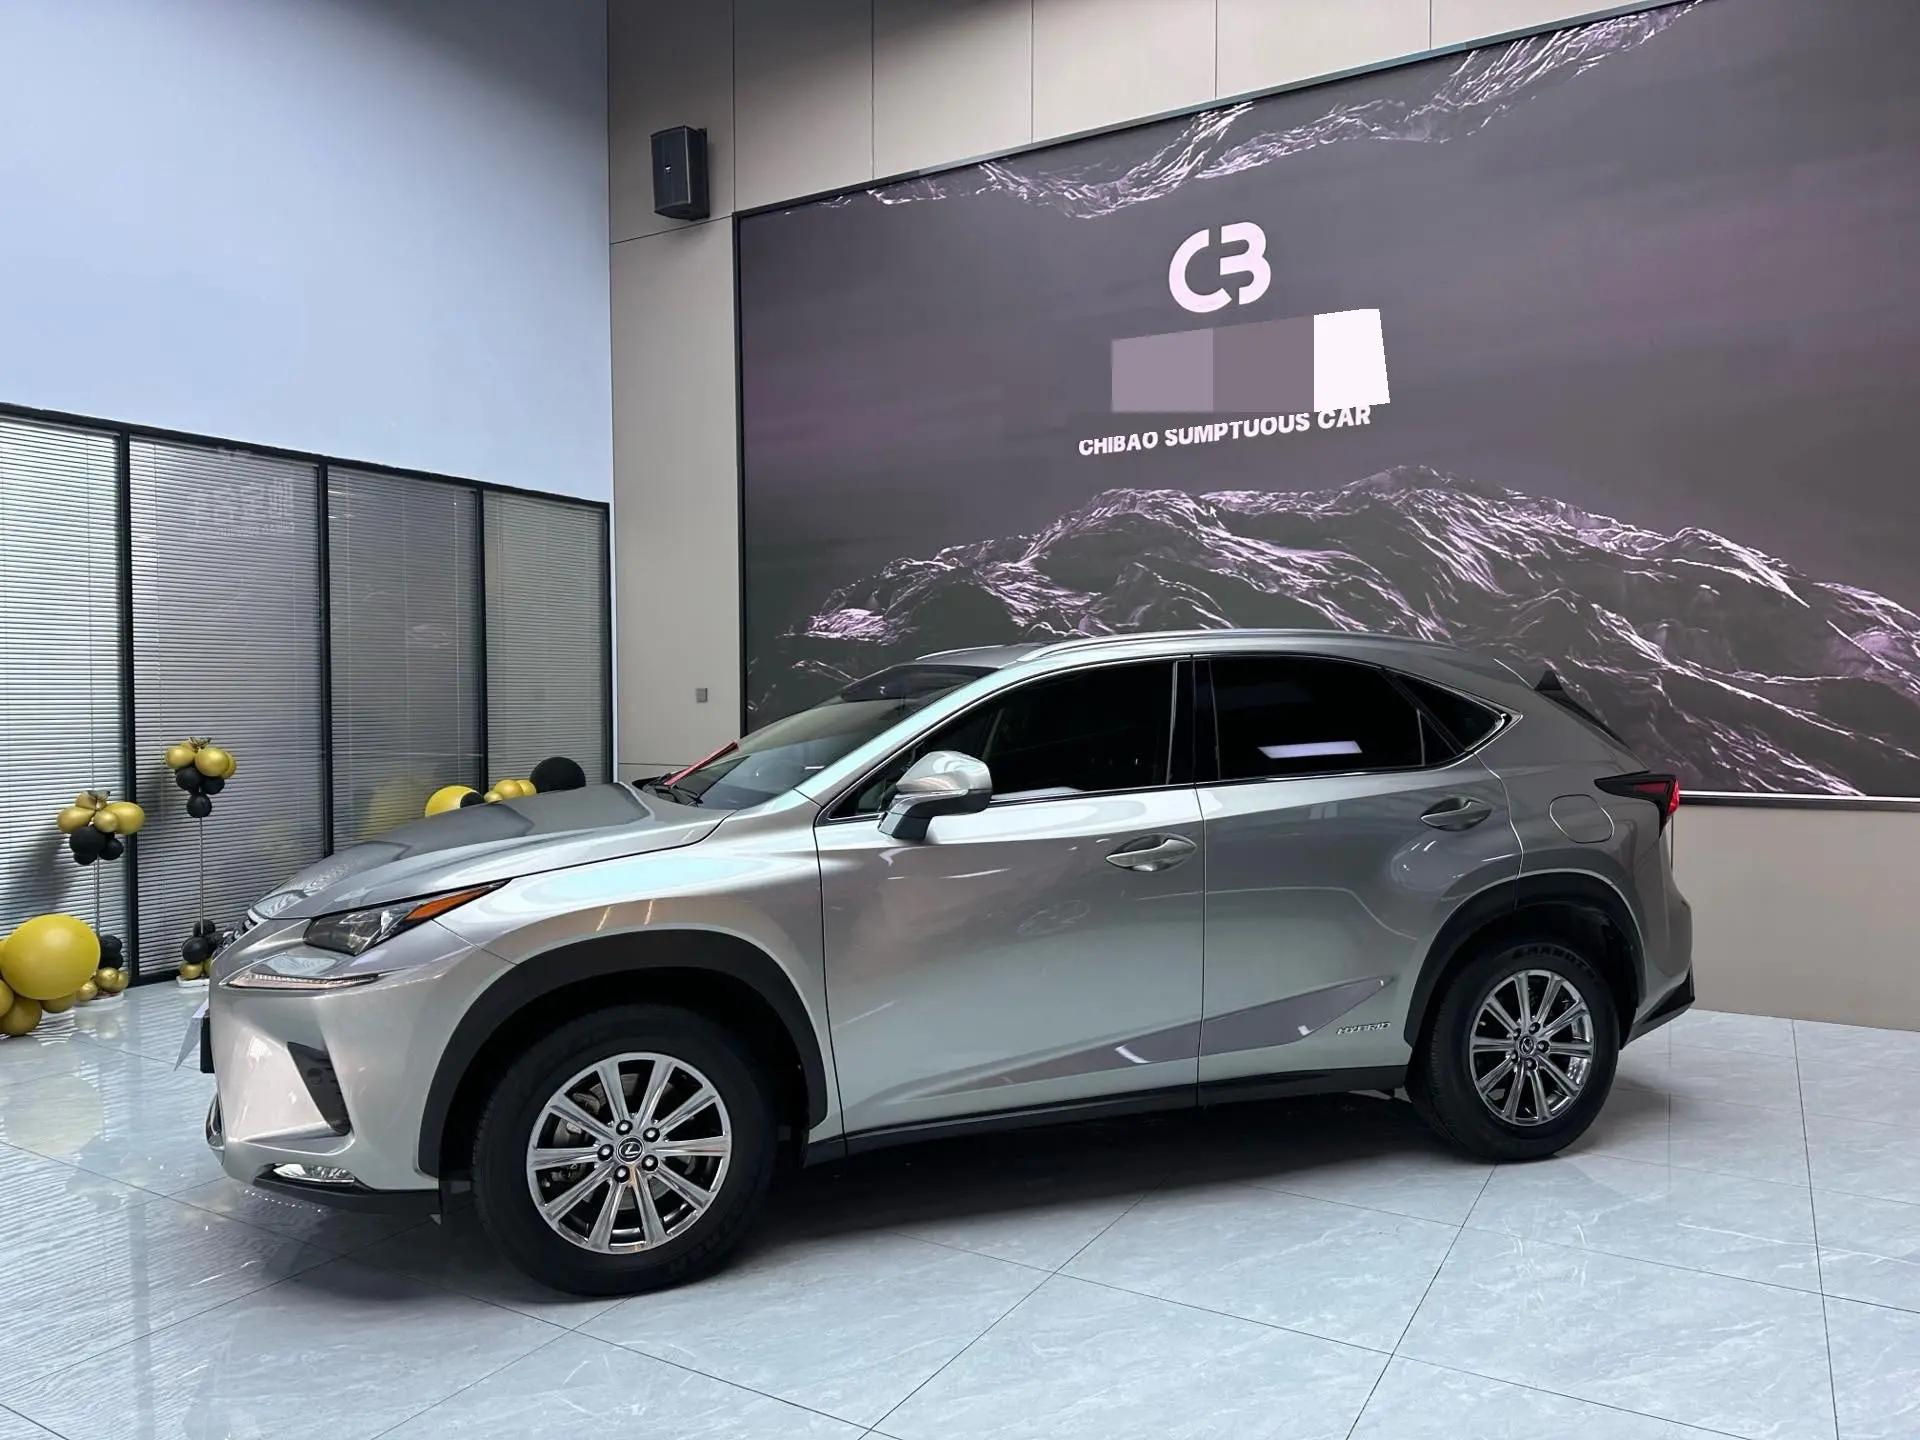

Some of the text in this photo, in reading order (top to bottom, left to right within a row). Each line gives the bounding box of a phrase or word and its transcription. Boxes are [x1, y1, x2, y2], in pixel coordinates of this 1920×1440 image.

[1168, 221, 1272, 313] CB
[1078, 405, 1371, 456] CHIBAO SUMPTUOUS CAR
[1337, 1022, 1391, 1035] HYBRID
